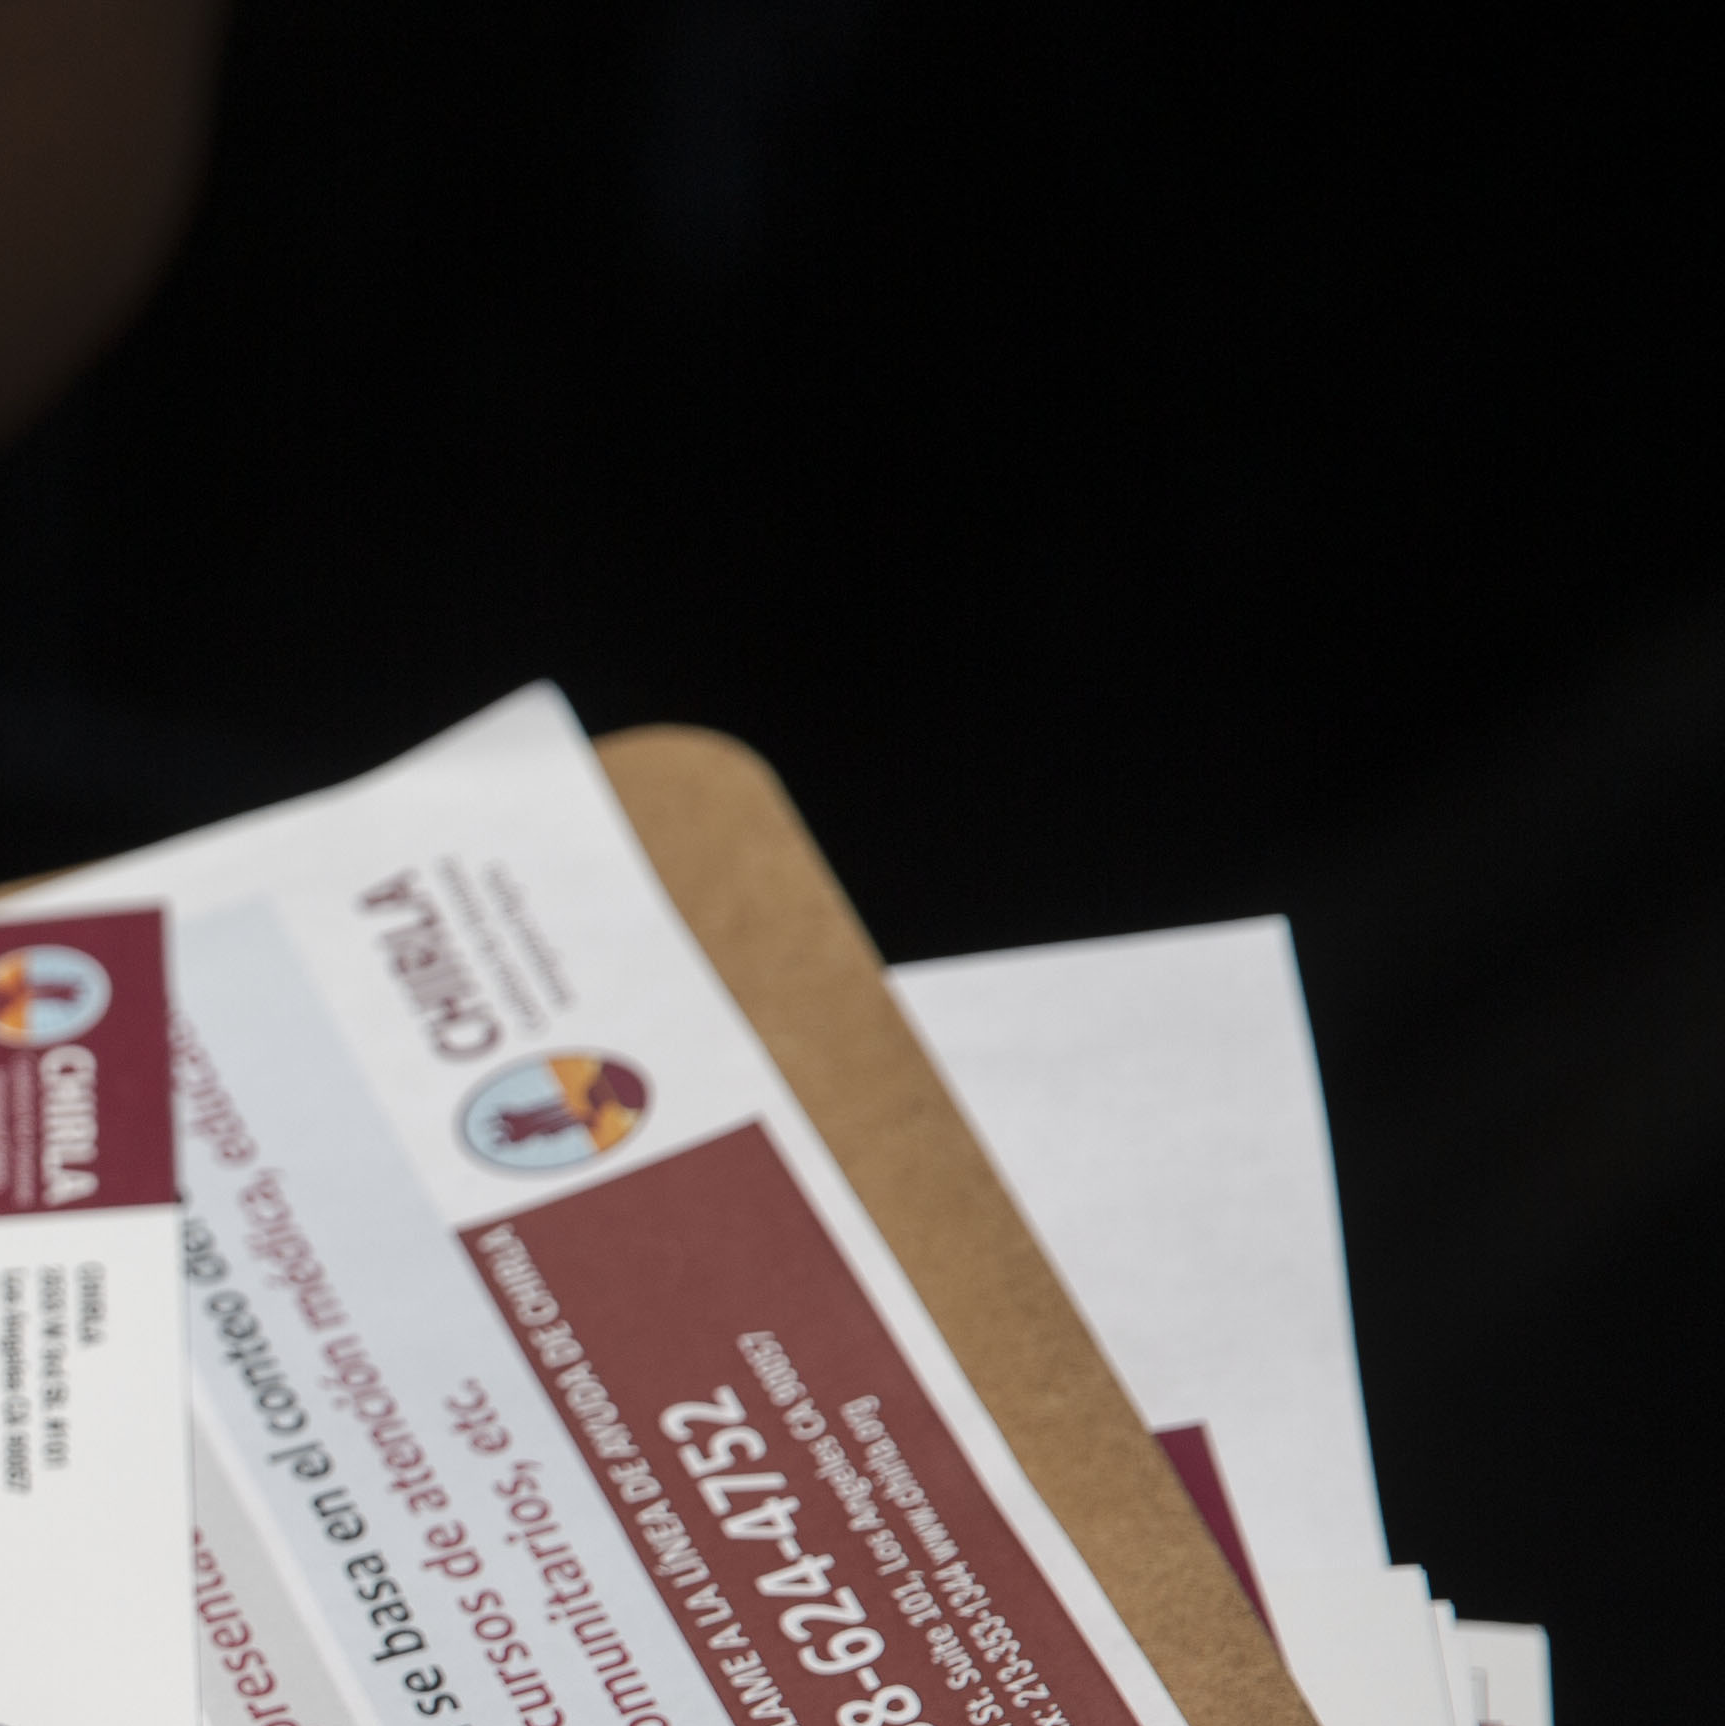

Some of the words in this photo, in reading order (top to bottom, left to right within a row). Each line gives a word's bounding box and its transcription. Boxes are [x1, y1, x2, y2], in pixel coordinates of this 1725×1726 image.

[357, 870, 502, 1059] CHIRLA
[39, 1045, 99, 1204] CHIRLA
[244, 1168, 349, 1329] médica,
[481, 1225, 559, 1326] CHIRLA
[206, 1292, 308, 1436] conteo
[532, 1326, 581, 1367] DE
[323, 1336, 449, 1514] atención
[447, 1379, 511, 1455] etc.
[558, 1361, 639, 1458] AYUDA
[786, 1398, 827, 1440] CA
[269, 1442, 334, 1481] el
[609, 1458, 662, 1503] DE
[812, 1435, 885, 1532] Angeles
[841, 1395, 959, 1565] www.chirla.org
[312, 1489, 366, 1543] en
[422, 1522, 483, 1580] de
[637, 1499, 710, 1588] LÍNEA
[867, 1529, 910, 1576] Los
[345, 1553, 426, 1663] basa
[685, 1583, 734, 1627] LA
[893, 1570, 942, 1627] 101,
[708, 1622, 750, 1649] A
[927, 1623, 982, 1690] Suite
[935, 1561, 1051, 1708] 213-353-1344
[404, 1667, 460, 1716] se
[966, 1686, 1004, 1726] St.
